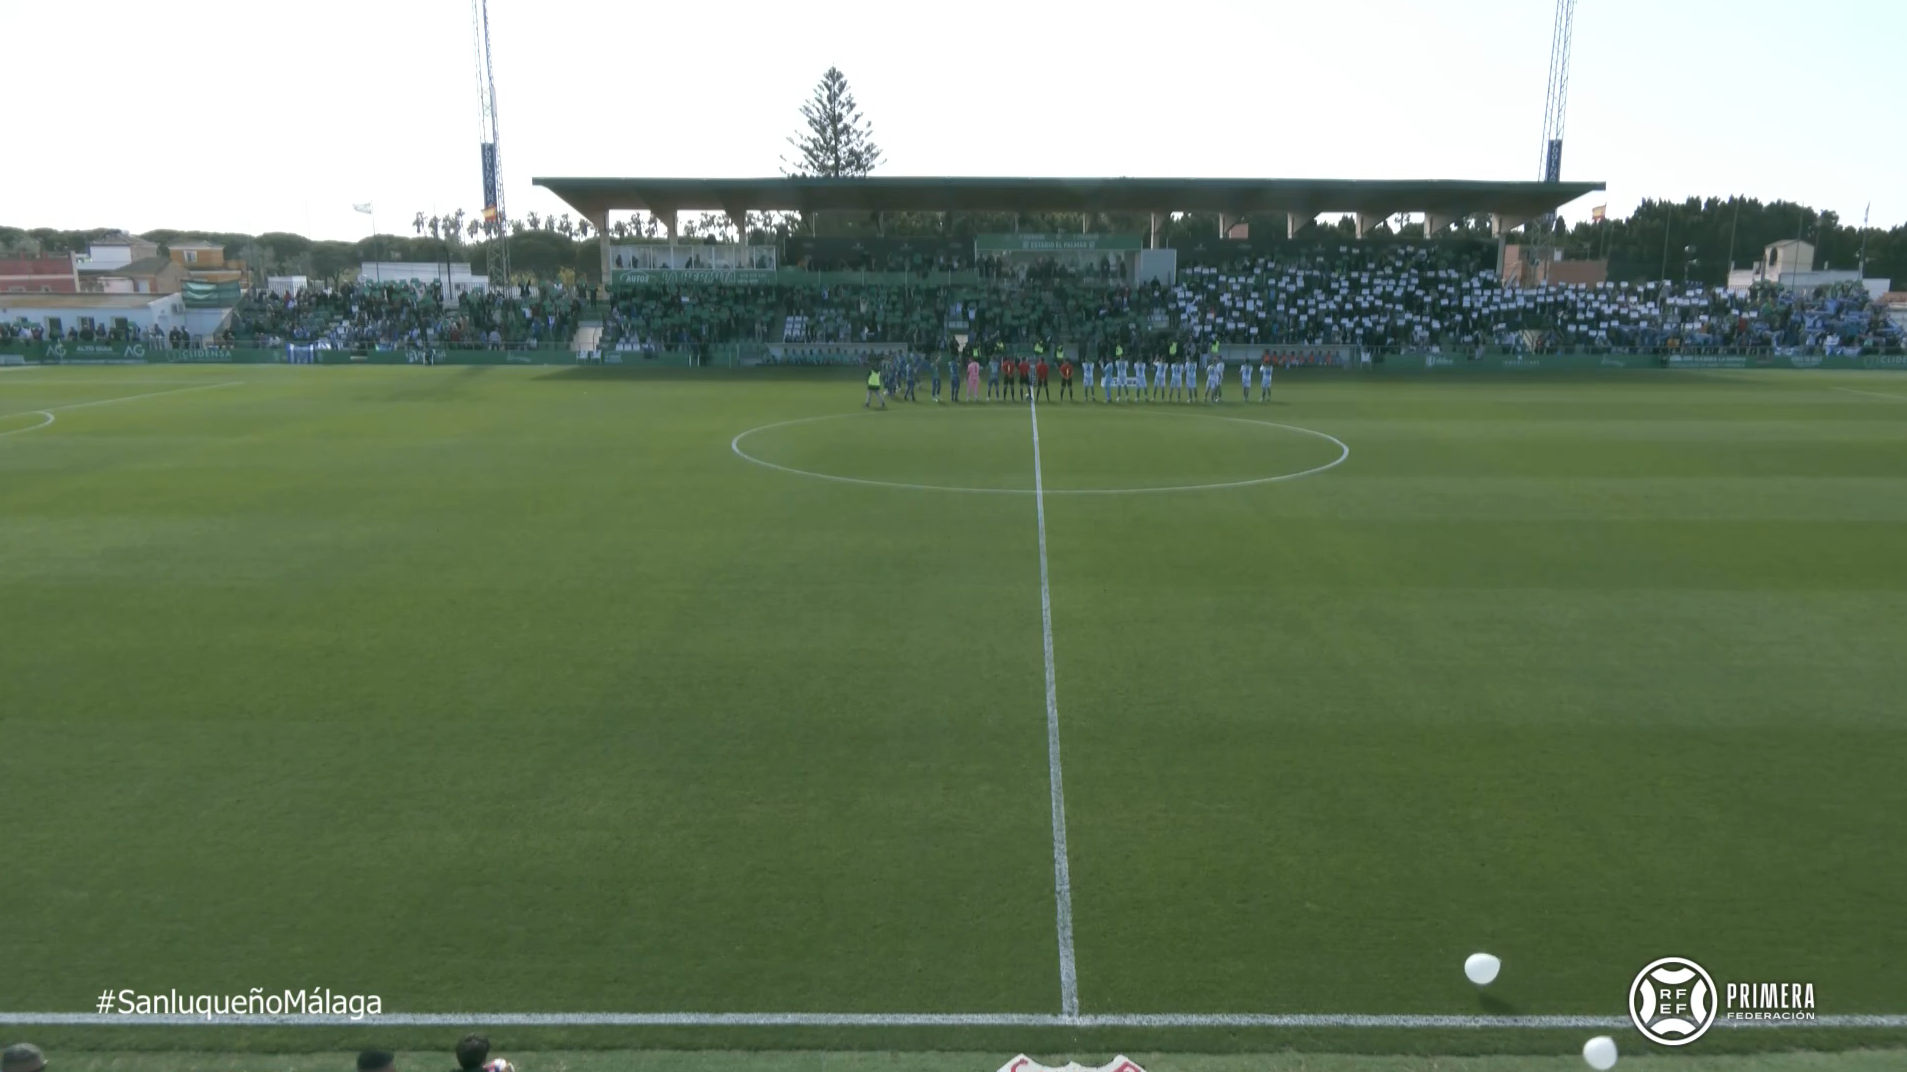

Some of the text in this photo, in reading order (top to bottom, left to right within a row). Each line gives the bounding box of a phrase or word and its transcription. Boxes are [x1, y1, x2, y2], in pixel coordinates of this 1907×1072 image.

[1030, 240, 1055, 249] ESTADIO
[1055, 240, 1062, 249] EL
[626, 275, 649, 283] AUTOS
[124, 344, 145, 357] AG
[182, 349, 232, 359] CLIDENSA
